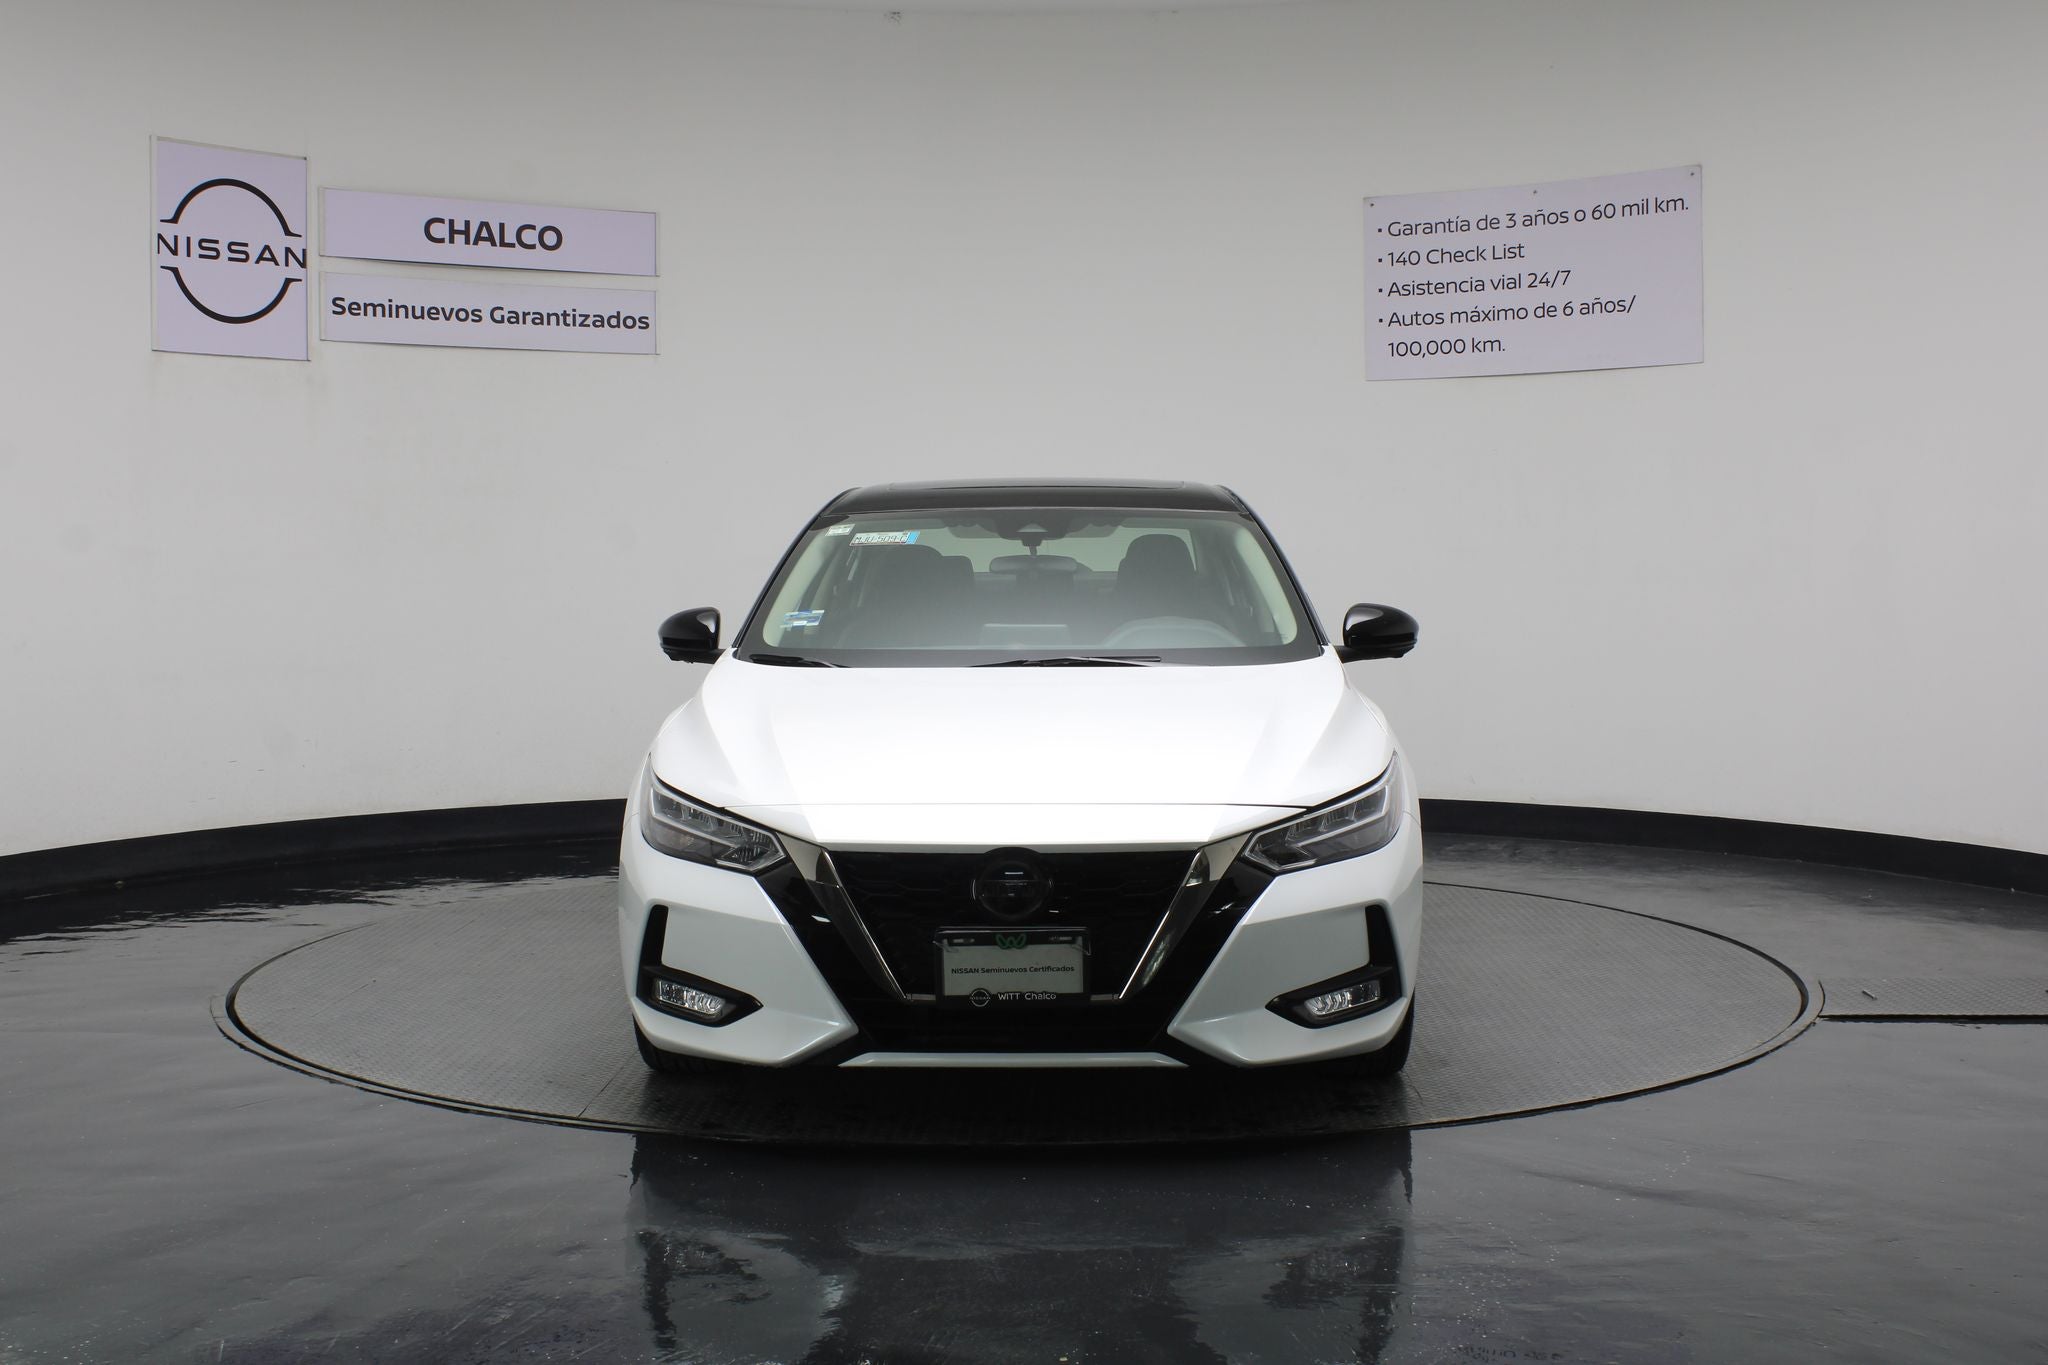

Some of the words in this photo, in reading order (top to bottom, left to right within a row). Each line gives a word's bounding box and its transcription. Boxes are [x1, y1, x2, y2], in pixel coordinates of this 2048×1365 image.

[1388, 215, 1471, 237] Garantía
[1475, 213, 1501, 231] de
[1505, 212, 1517, 229] 3
[1521, 208, 1570, 228] años
[1573, 208, 1587, 223] o
[1591, 202, 1617, 221] 60
[1621, 198, 1650, 218] mil
[1654, 196, 1689, 214] km.
[424, 216, 564, 251] CHALCO
[156, 232, 308, 269] NISSAN
[1388, 249, 1421, 267] 140
[1426, 244, 1487, 265] Check
[1492, 242, 1526, 260] List
[1387, 276, 1486, 297] Asistencia
[1489, 272, 1522, 291] vial
[1527, 269, 1572, 289] 24/7
[331, 296, 484, 324] Seminuevos
[489, 306, 650, 331] Garantizados
[1387, 311, 1445, 328] Autos
[1449, 305, 1529, 325] máximo
[1533, 301, 1558, 319] de
[1562, 301, 1575, 317] 6
[1579, 294, 1637, 316] años/
[1387, 338, 1467, 359] 100,000
[1471, 336, 1506, 354] km.
[951, 966, 980, 975] NISSAN
[981, 965, 1028, 974] Seminuevos
[1029, 964, 1075, 974] Certificados
[997, 992, 1021, 1001] WITT
[1024, 991, 1057, 1001] Chalco
